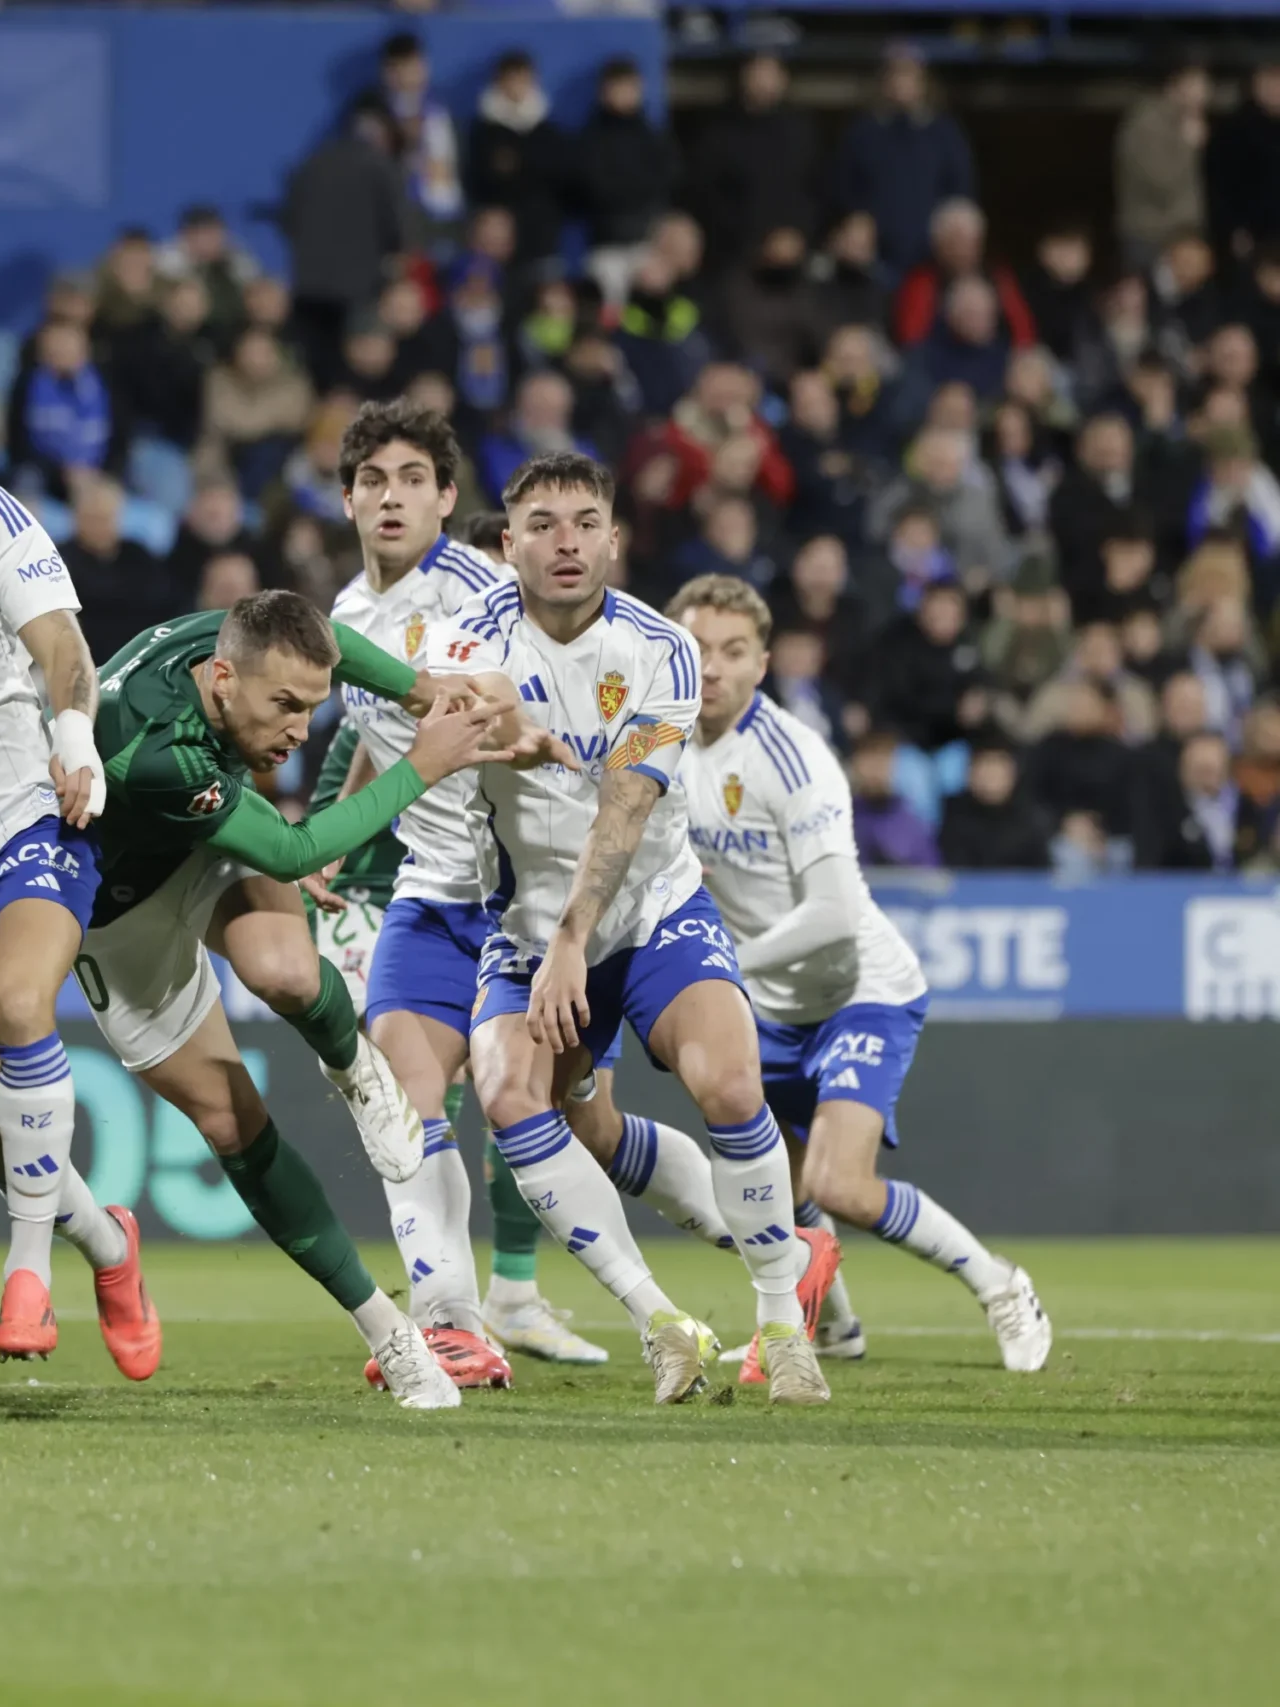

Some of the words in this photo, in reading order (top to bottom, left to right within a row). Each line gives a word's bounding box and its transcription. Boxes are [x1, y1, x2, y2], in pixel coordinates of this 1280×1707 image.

[16, 556, 62, 583] MGS
[21, 1110, 54, 1130] RZ
[742, 1184, 775, 1202] RZ
[396, 1217, 417, 1242] RZ
